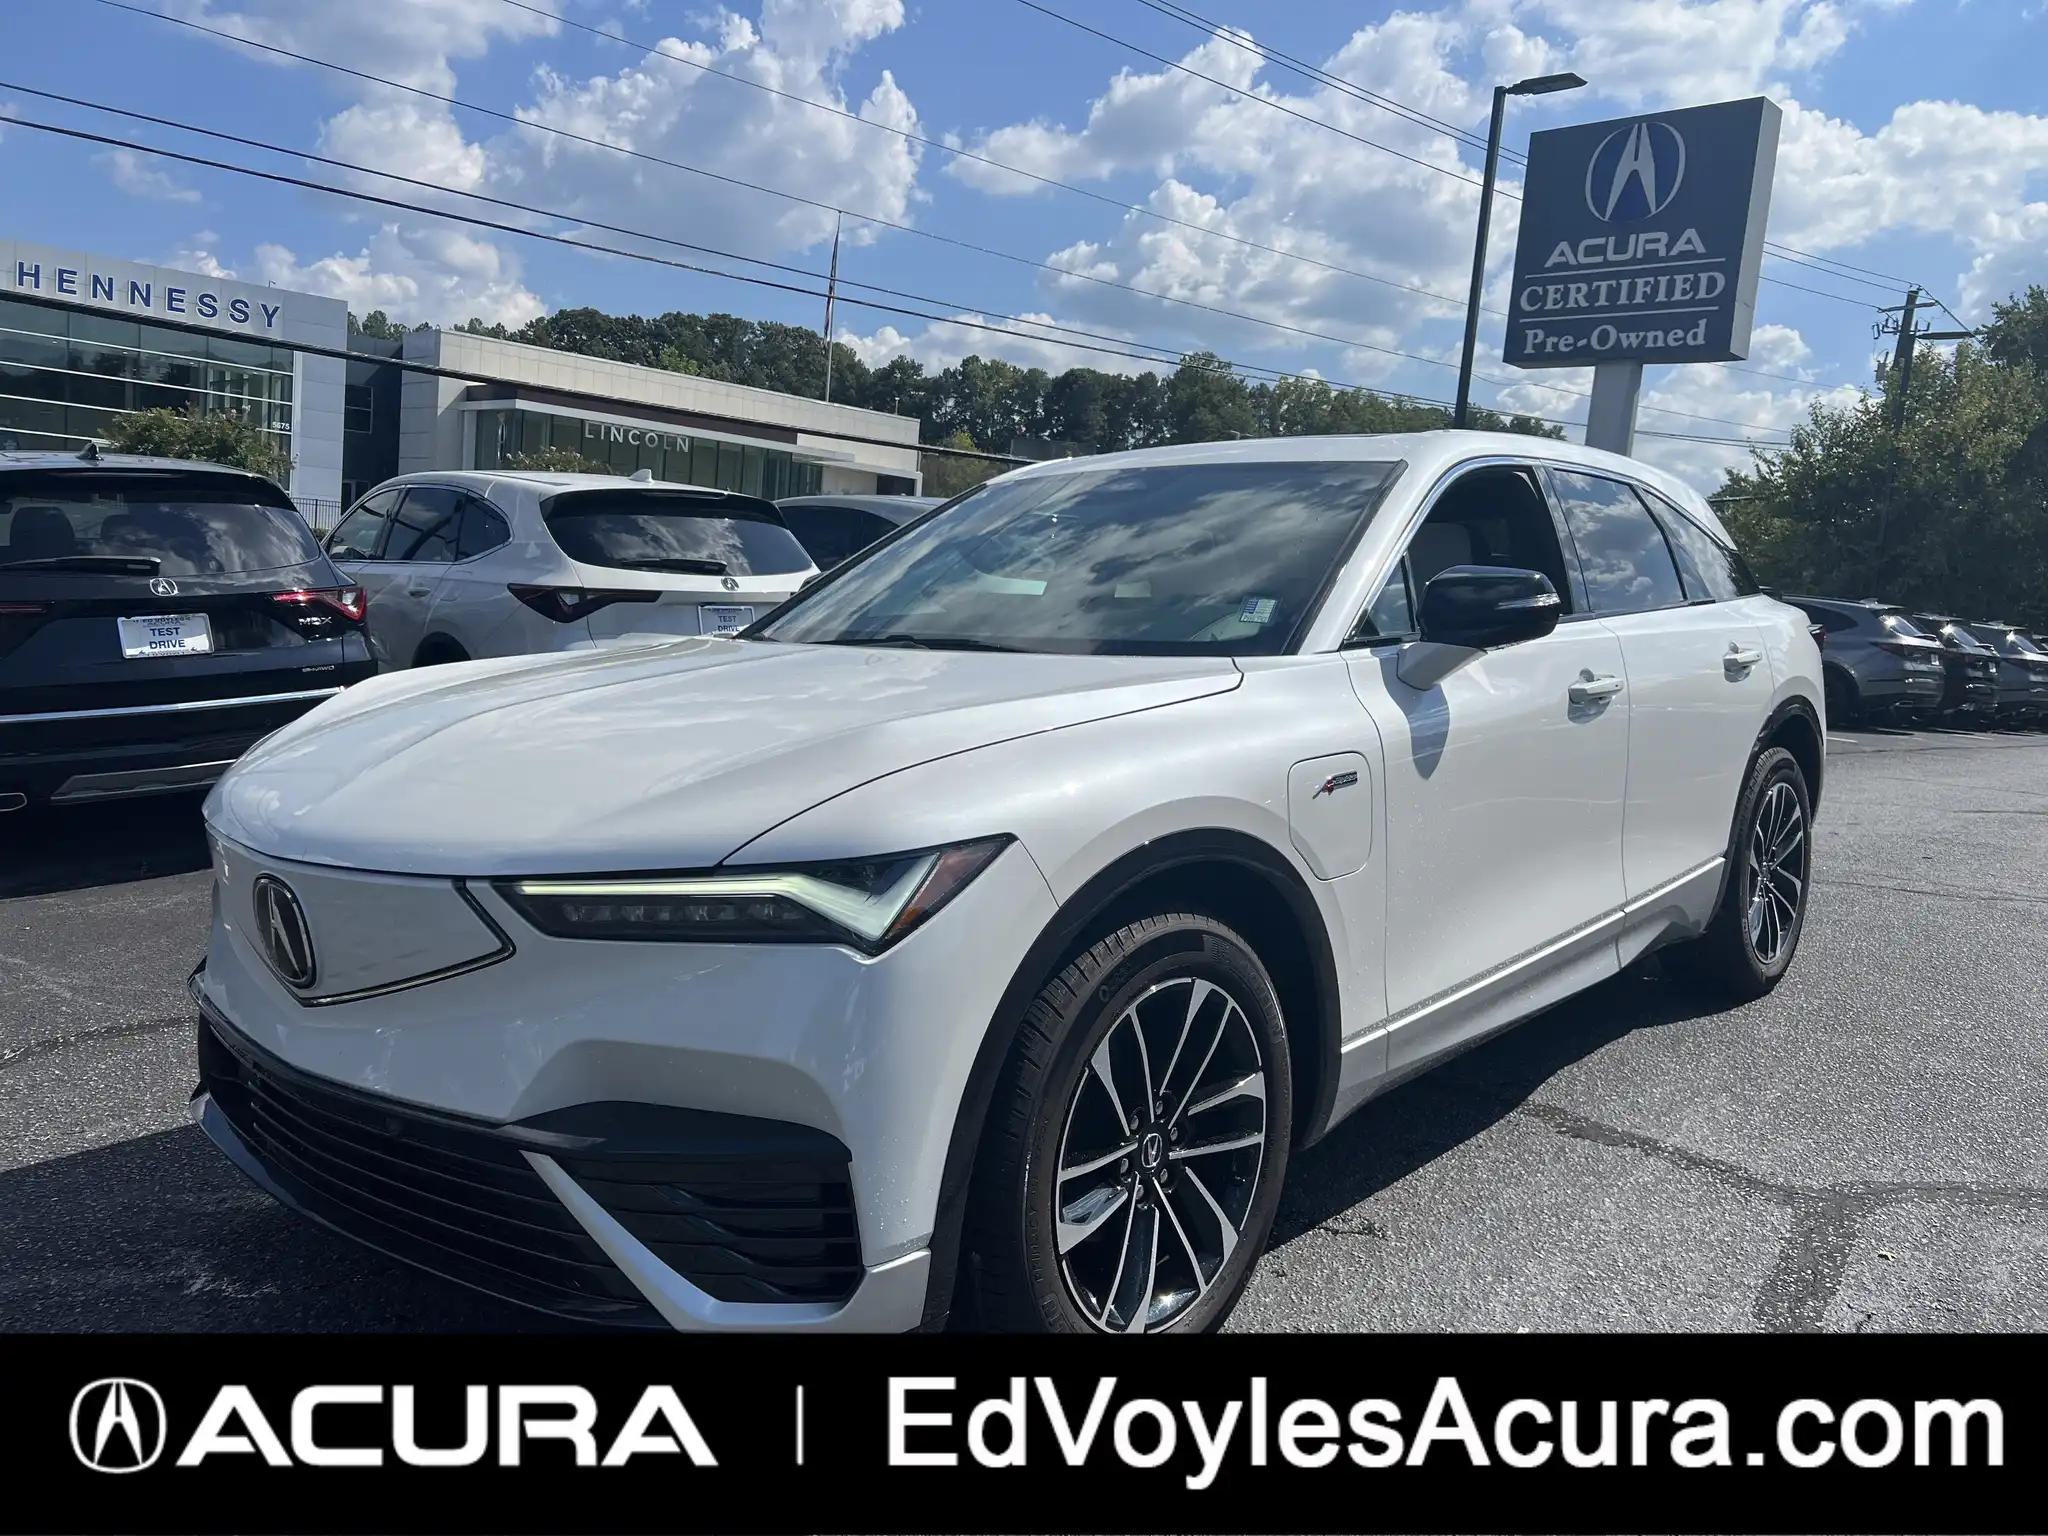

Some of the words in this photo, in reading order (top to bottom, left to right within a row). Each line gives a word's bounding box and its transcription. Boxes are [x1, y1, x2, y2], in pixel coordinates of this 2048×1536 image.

[1544, 228, 1706, 268] ACURA
[17, 260, 281, 328] HENNESSY
[1520, 271, 1726, 312] CERTIFIED
[1523, 318, 1708, 354] Pre-Owned
[585, 421, 689, 453] LINCOLN
[149, 626, 181, 637] TEST
[718, 615, 737, 623] TEST
[149, 639, 186, 650] DRIVE
